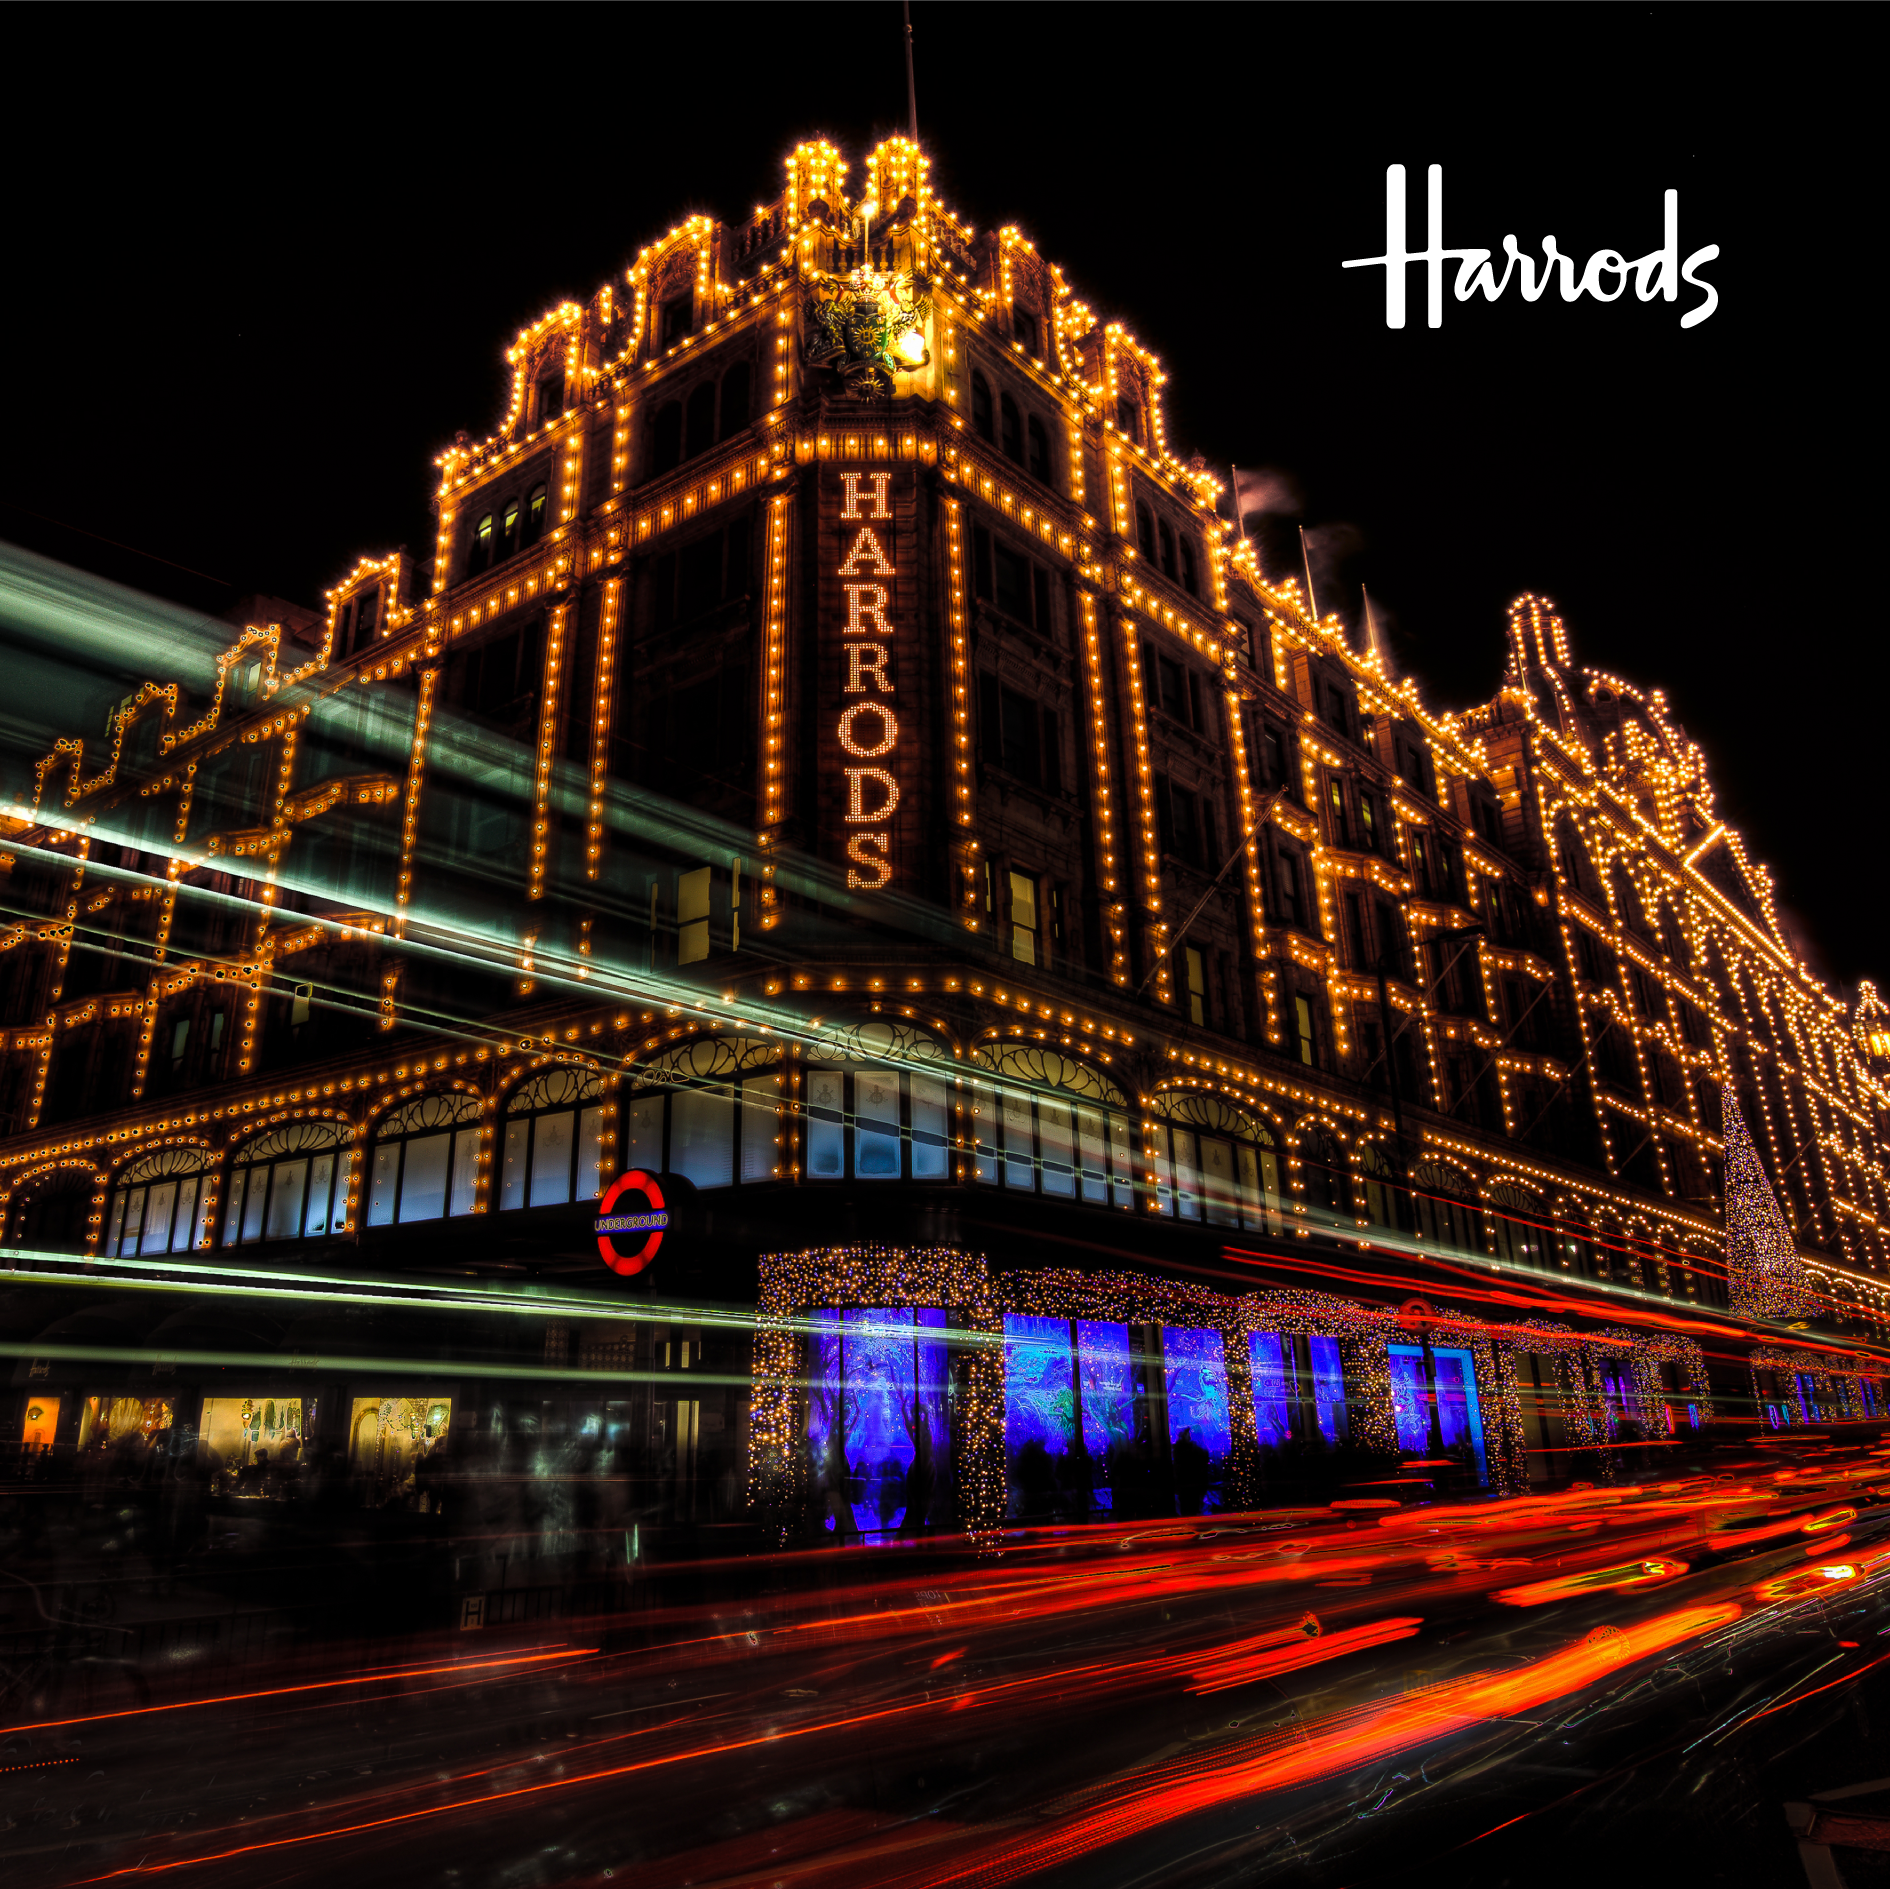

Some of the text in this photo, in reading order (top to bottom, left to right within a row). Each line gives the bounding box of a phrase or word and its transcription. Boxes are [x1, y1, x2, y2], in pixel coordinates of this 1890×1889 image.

[837, 471, 900, 889] HARRODS
[594, 1213, 669, 1232] UNDERGROUND
[464, 1599, 483, 1628] H
